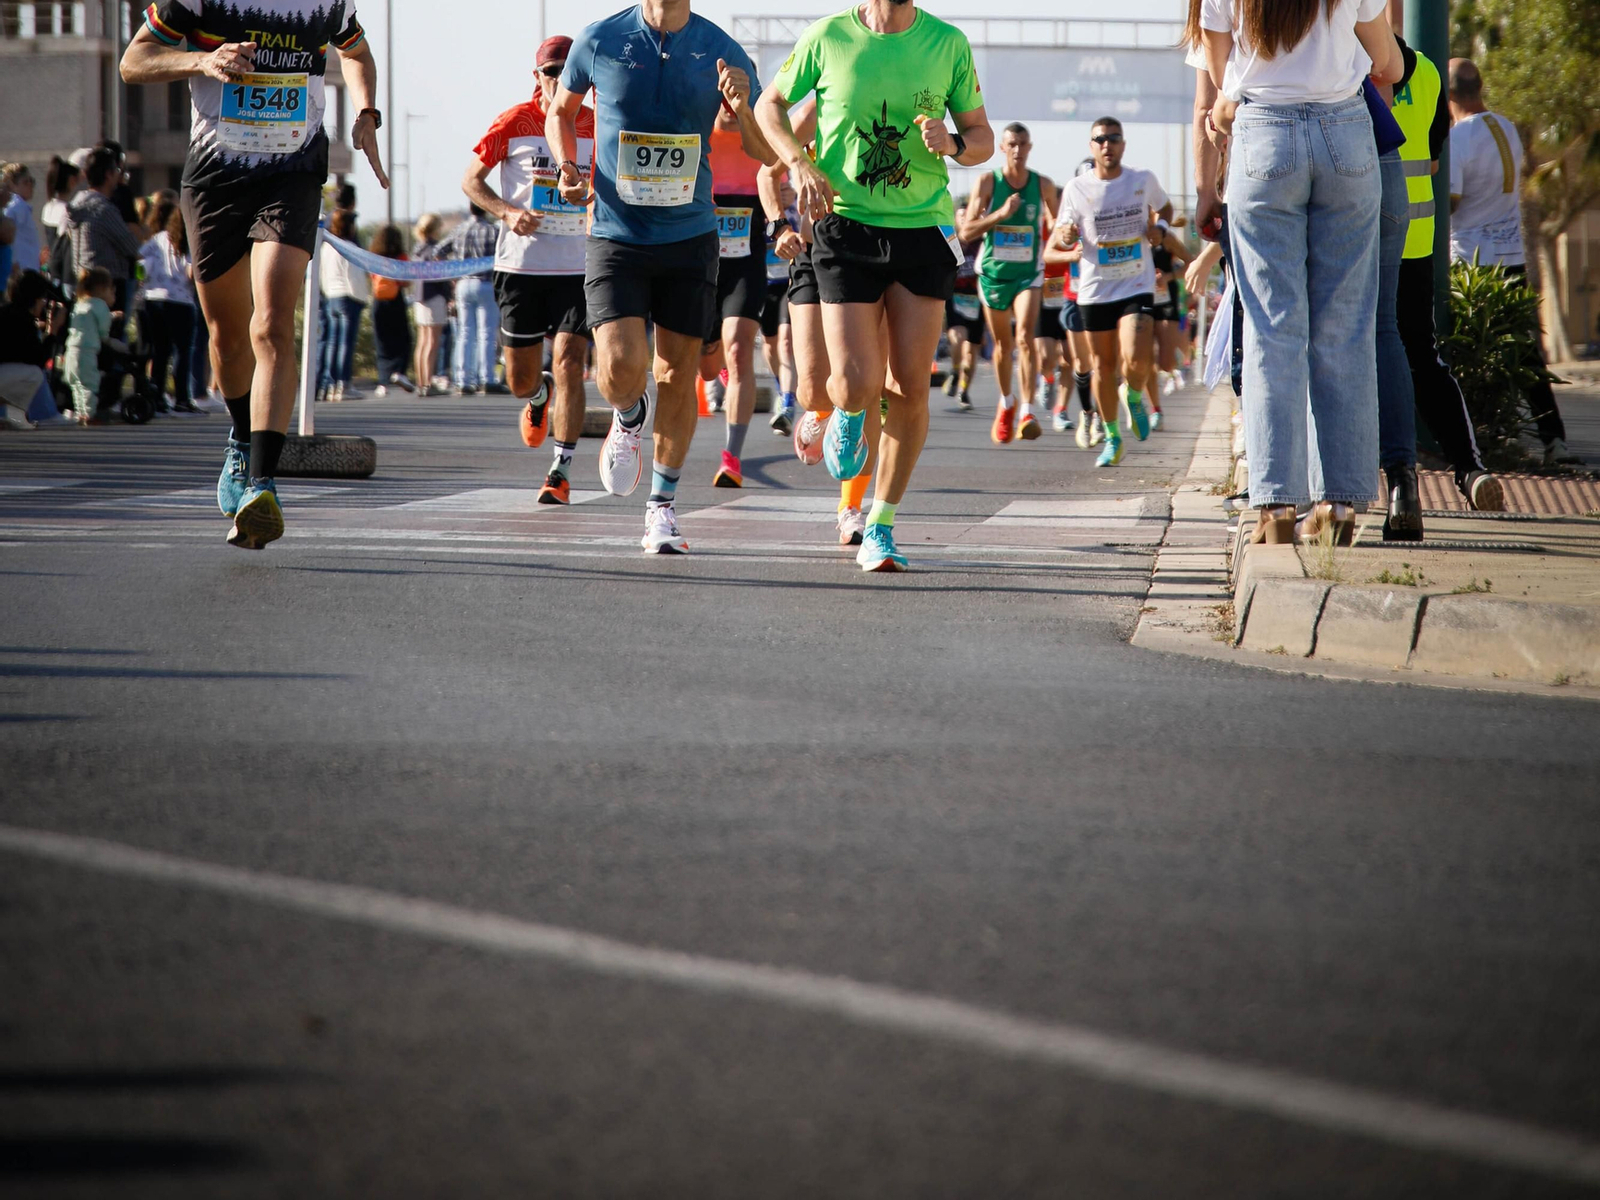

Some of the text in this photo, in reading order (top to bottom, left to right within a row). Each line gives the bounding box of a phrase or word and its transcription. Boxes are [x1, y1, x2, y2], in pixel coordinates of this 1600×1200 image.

[245, 30, 303, 51] TRAIL
[249, 48, 313, 69] MOLINETA
[232, 86, 299, 111] 1548
[237, 110, 292, 119] JOSE VIZCAINO
[531, 156, 549, 167] VIII
[636, 146, 685, 168] 979
[637, 168, 664, 176] DAMIAN
[717, 216, 746, 231] 190
[1107, 245, 1134, 259] 957
